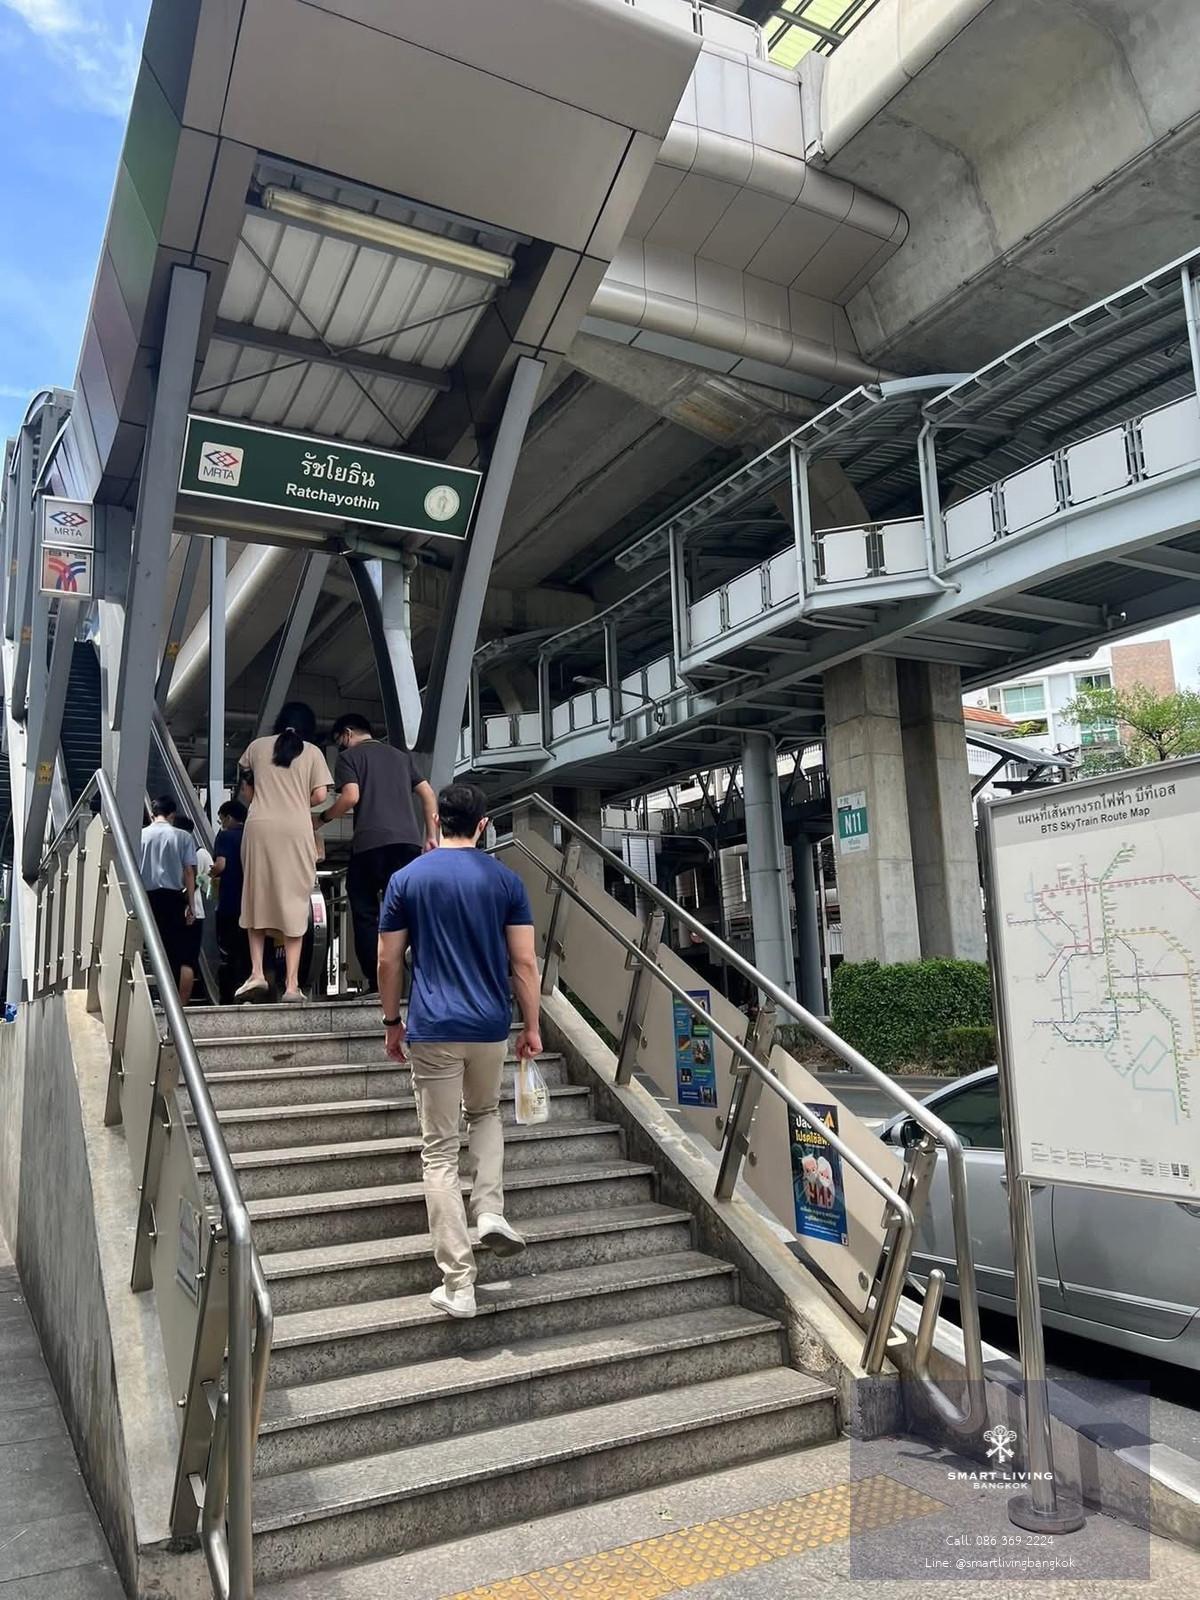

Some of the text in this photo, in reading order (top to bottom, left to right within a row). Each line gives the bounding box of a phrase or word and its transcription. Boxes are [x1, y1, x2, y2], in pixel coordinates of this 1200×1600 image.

[203, 466, 235, 481] MRTA
[301, 451, 376, 488] รัชโยธิน
[286, 483, 380, 511] Ratchayothin
[54, 527, 82, 536] MRTA
[1017, 790, 1132, 825] แผนที่เส้นทางรถไฟฟ้า
[1040, 806, 1150, 834] BTS SkyTrain Route Map
[845, 812, 862, 834] N11
